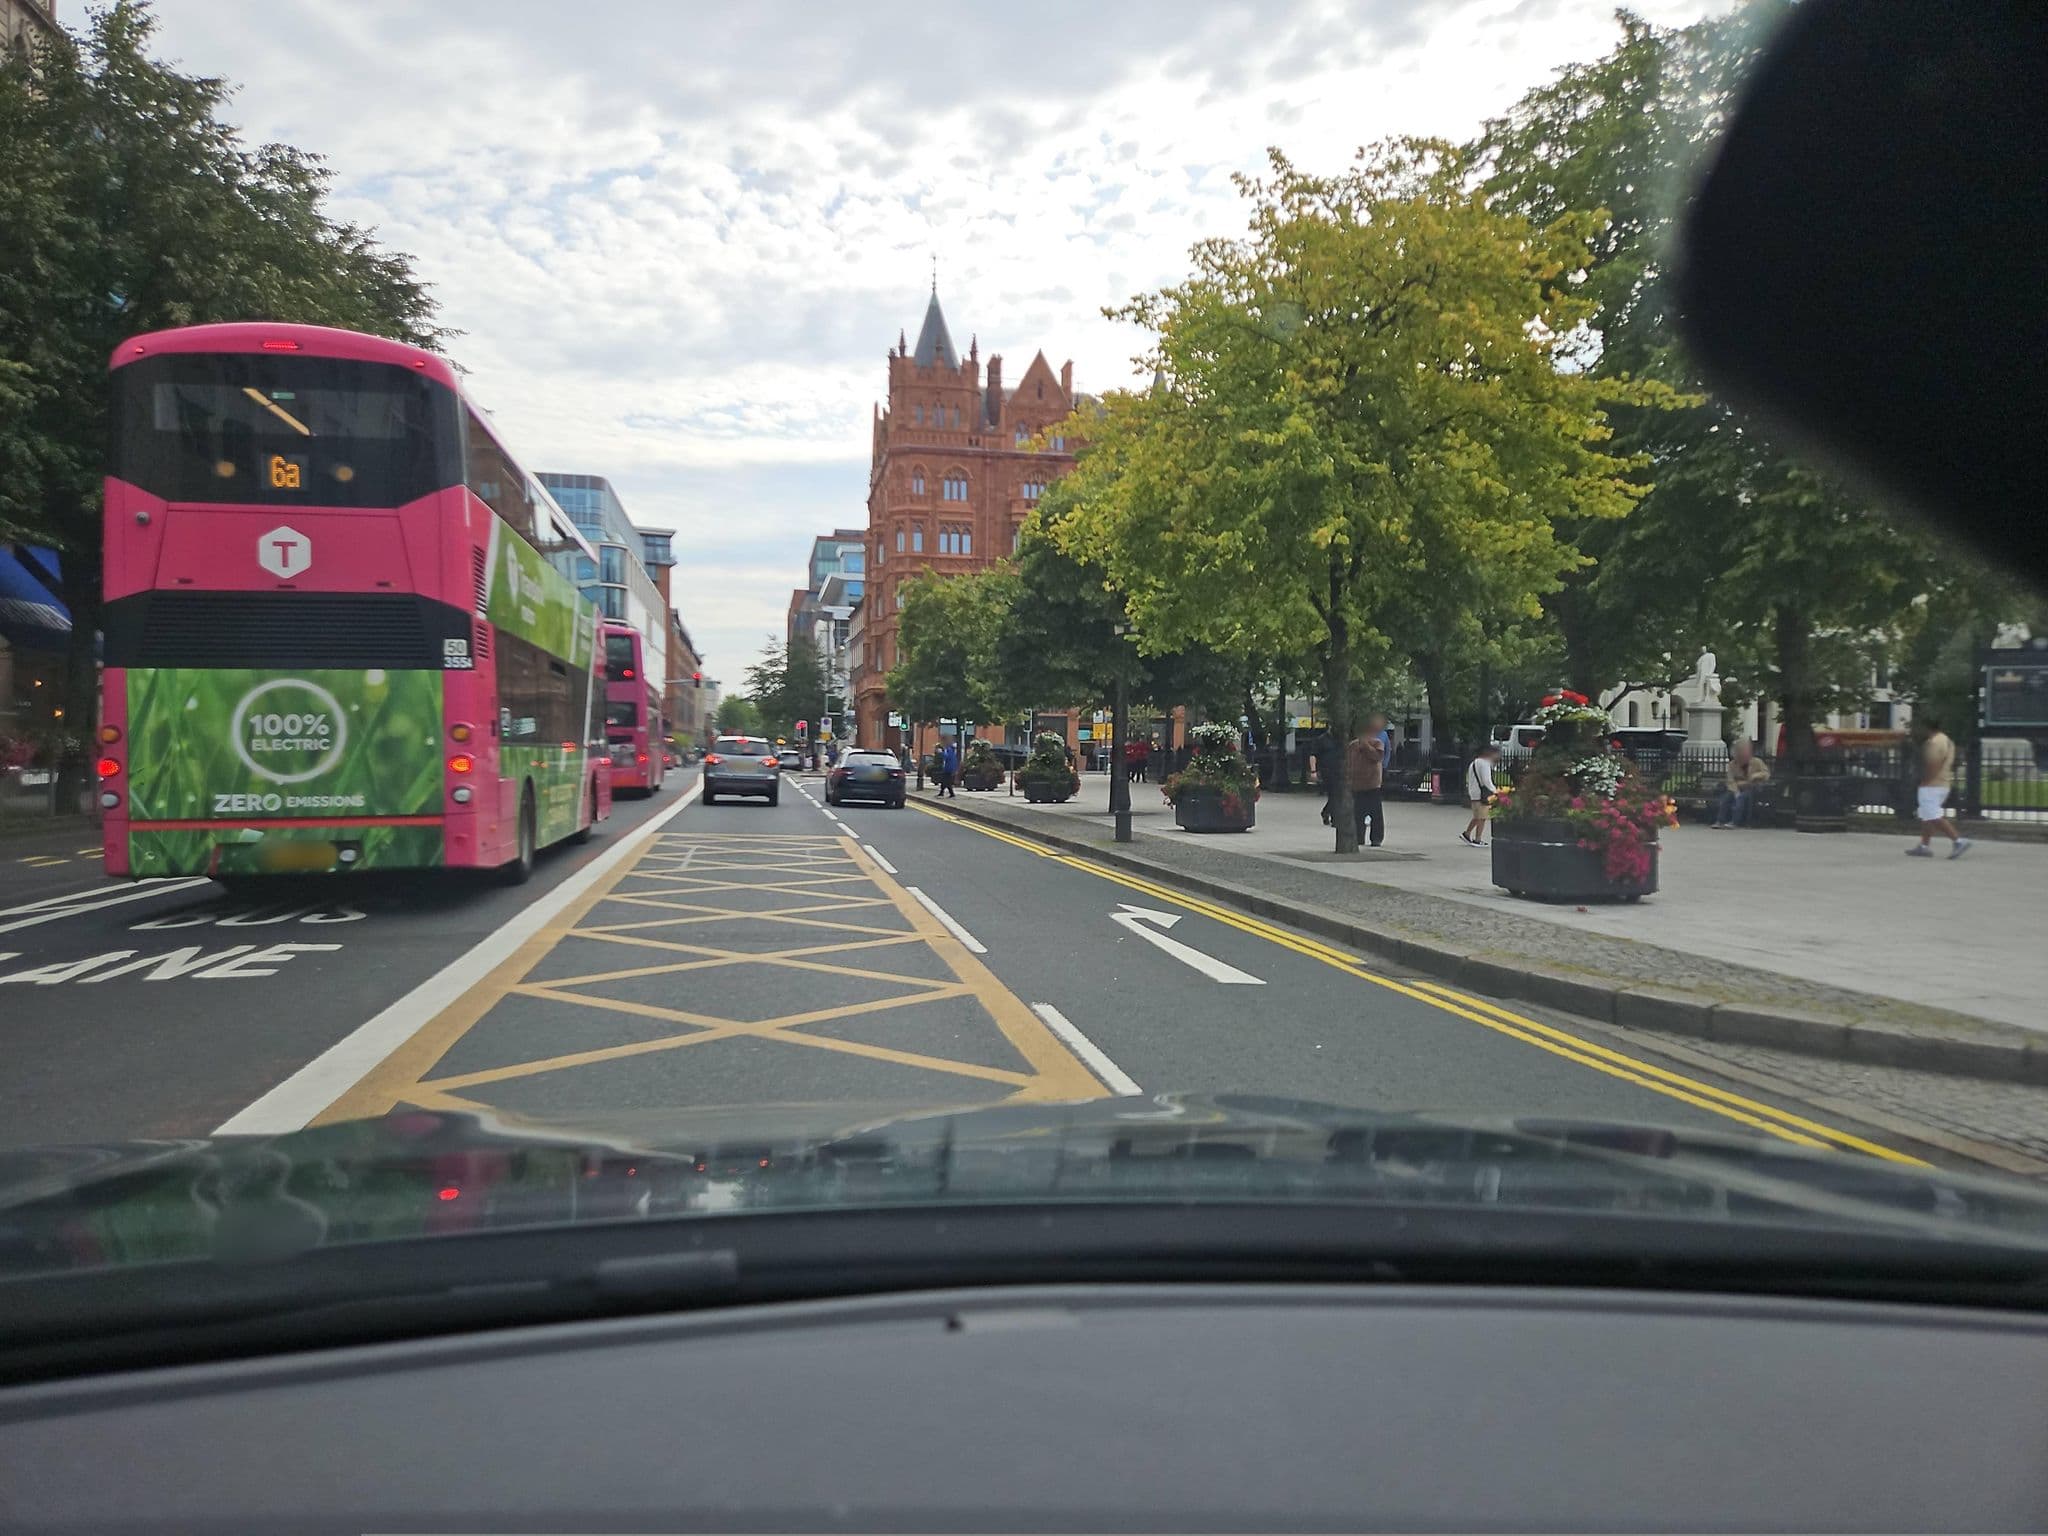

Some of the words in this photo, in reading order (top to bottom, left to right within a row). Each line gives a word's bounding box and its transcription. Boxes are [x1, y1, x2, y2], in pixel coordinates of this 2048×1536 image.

[271, 456, 300, 488] 6a
[447, 641, 466, 654] 50
[249, 713, 330, 736] 100%
[251, 738, 331, 751] ELECTRIC
[214, 793, 282, 812] ZERO
[286, 795, 366, 808] EMISSIONS
